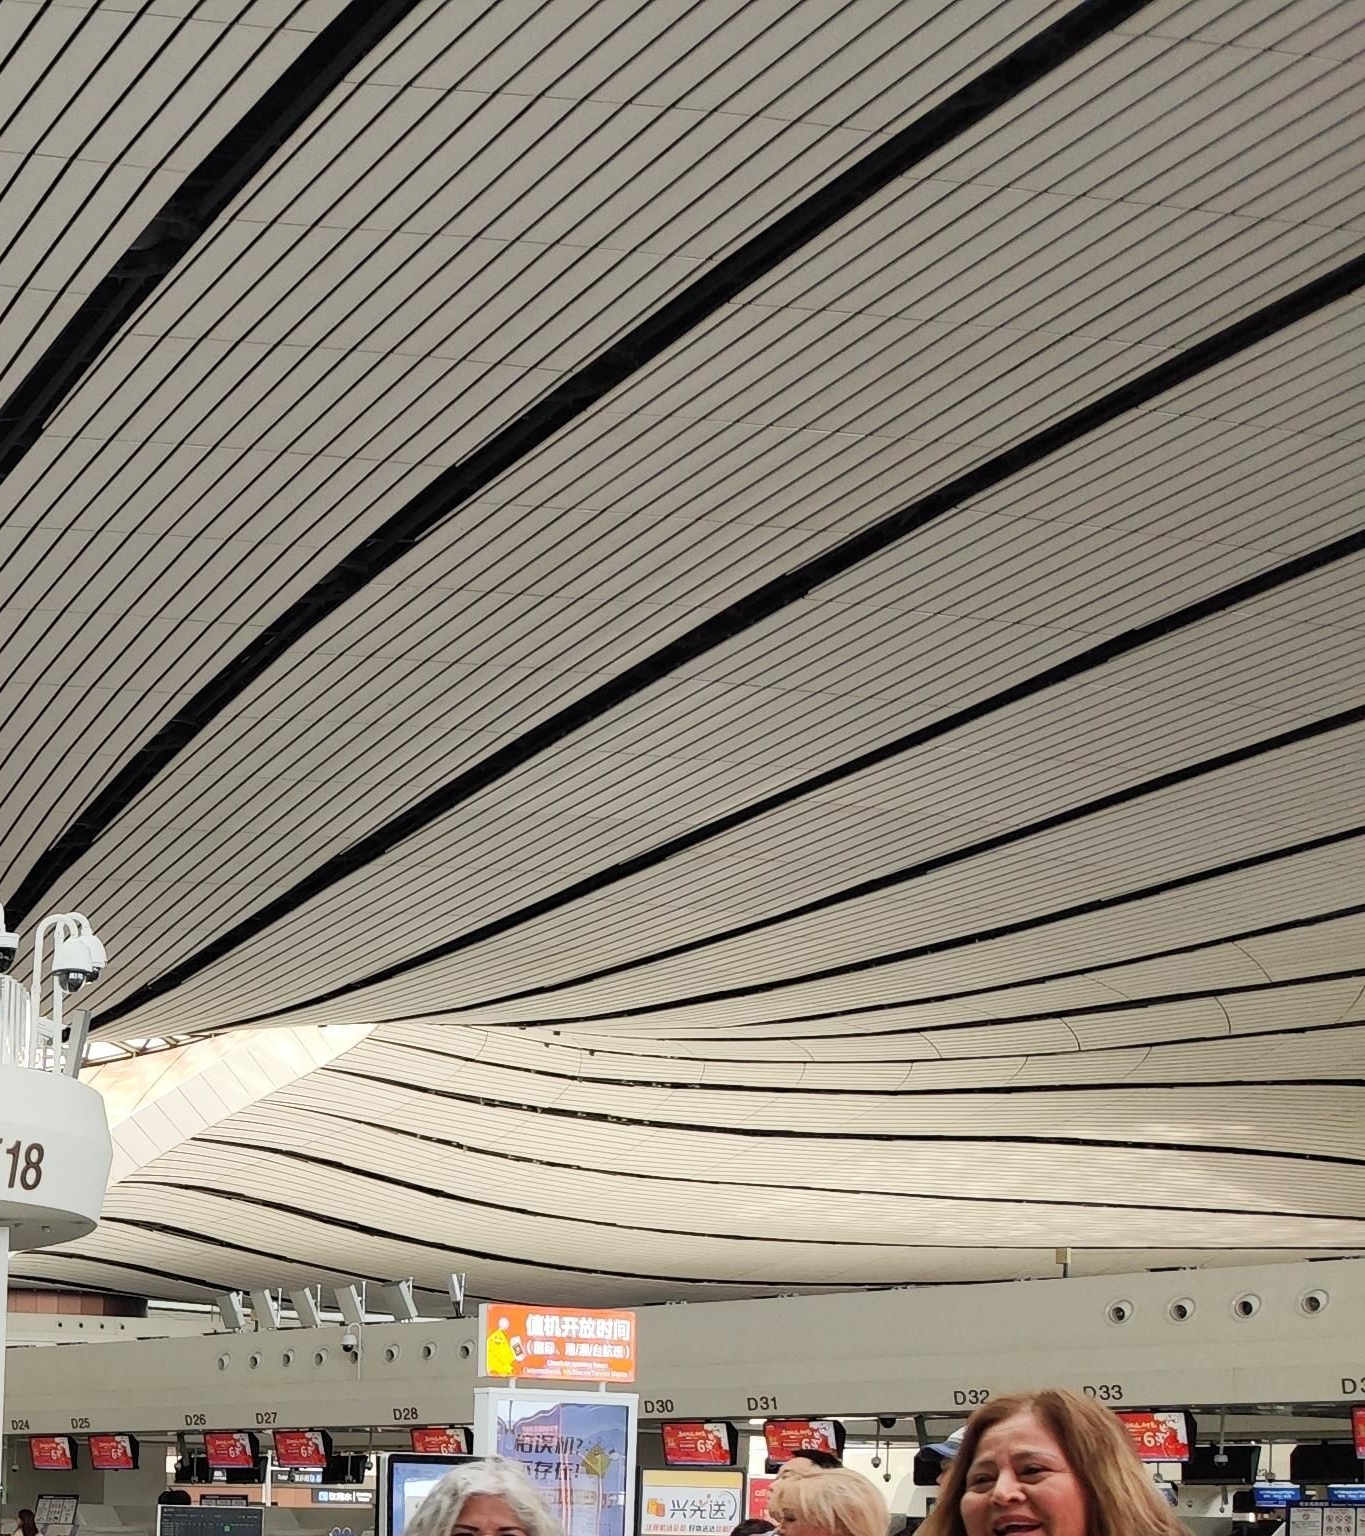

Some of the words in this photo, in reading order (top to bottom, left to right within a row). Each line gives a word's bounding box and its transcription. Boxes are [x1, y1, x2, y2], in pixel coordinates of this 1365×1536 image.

[526, 1314, 630, 1341] 值机开放时间
[954, 1389, 990, 1406] D32
[1083, 1385, 1123, 1401] D33
[644, 1399, 674, 1414] D30
[747, 1397, 778, 1411] D31
[185, 1414, 206, 1426] D26
[256, 1412, 277, 1424] D27
[393, 1408, 418, 1421] D28
[11, 1420, 29, 1430] D24
[71, 1418, 90, 1429] D25
[670, 1499, 726, 1520] 兴先送
